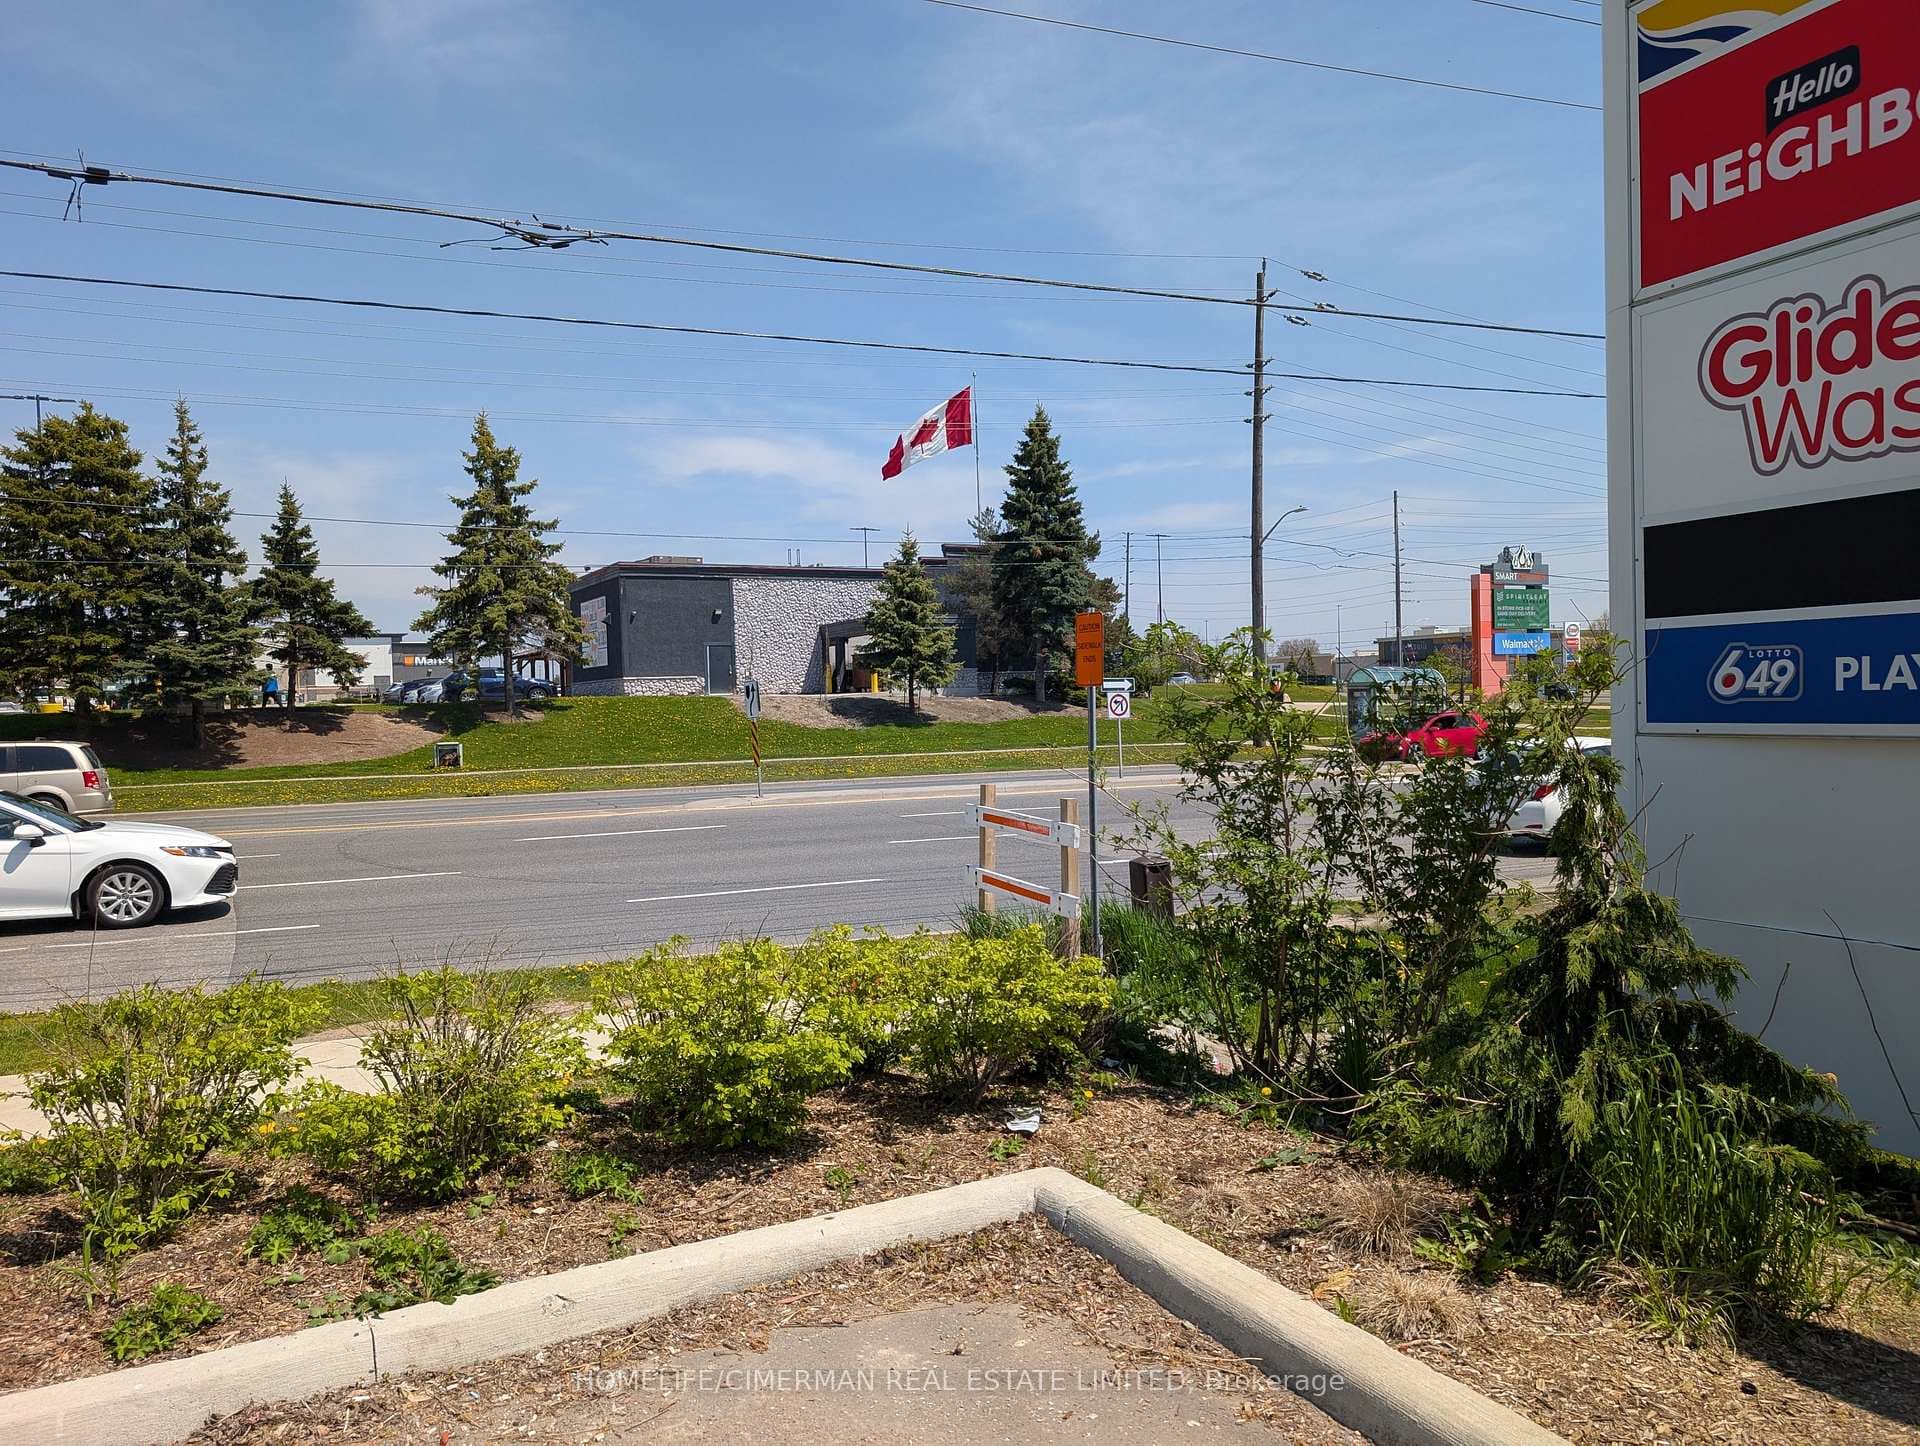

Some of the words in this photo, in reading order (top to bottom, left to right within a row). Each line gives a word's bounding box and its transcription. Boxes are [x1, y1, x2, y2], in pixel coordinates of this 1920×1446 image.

[1772, 62, 1853, 119] Hello
[1669, 87, 1920, 222] NEiGHB
[1495, 571, 1518, 581] SMART
[1502, 639, 1534, 649] Walmart
[1748, 649, 1792, 659] LOTTO
[1713, 649, 1796, 697] 649
[1835, 654, 1920, 692] PLA
